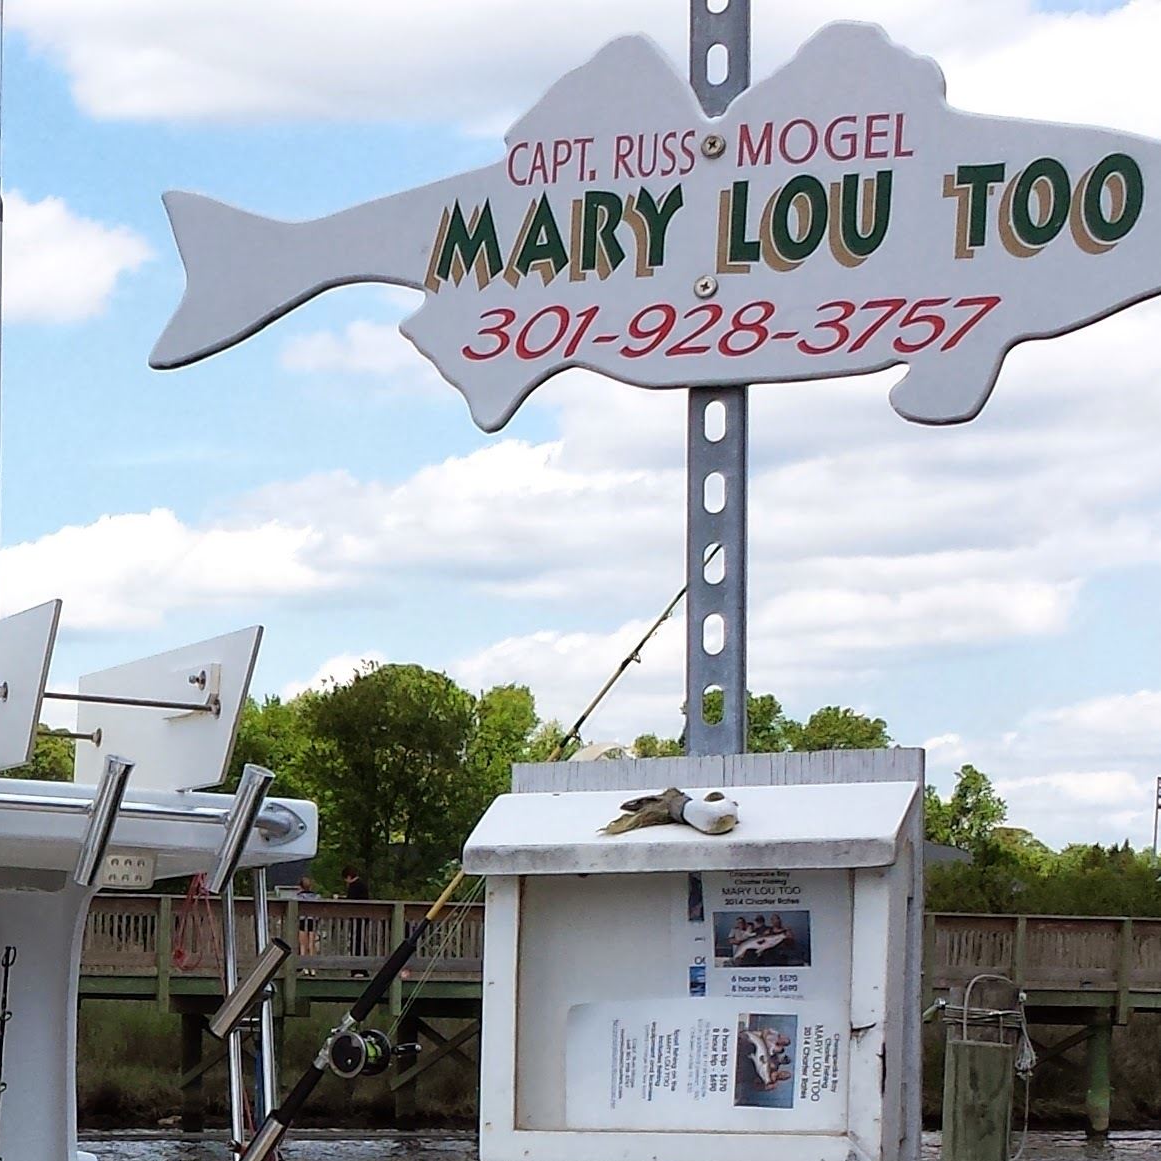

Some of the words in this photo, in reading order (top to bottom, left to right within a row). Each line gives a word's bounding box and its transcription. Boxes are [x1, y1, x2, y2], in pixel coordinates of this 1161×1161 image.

[507, 136, 596, 186] CAPT.
[614, 129, 696, 180] RUSS
[737, 112, 914, 168] MOGEL
[424, 183, 684, 294] MARY
[716, 169, 893, 275] LOU
[942, 152, 1144, 259] TOO
[460, 295, 1003, 362] 301-928-3757
[721, 887, 751, 895] MARY
[754, 886, 776, 895] LOU
[778, 886, 801, 895] TOO
[711, 1034, 720, 1052] hour
[721, 1034, 729, 1052] hour
[814, 1024, 824, 1053] MARY
[812, 1056, 822, 1077] LOU
[810, 1079, 821, 1102] TOO
